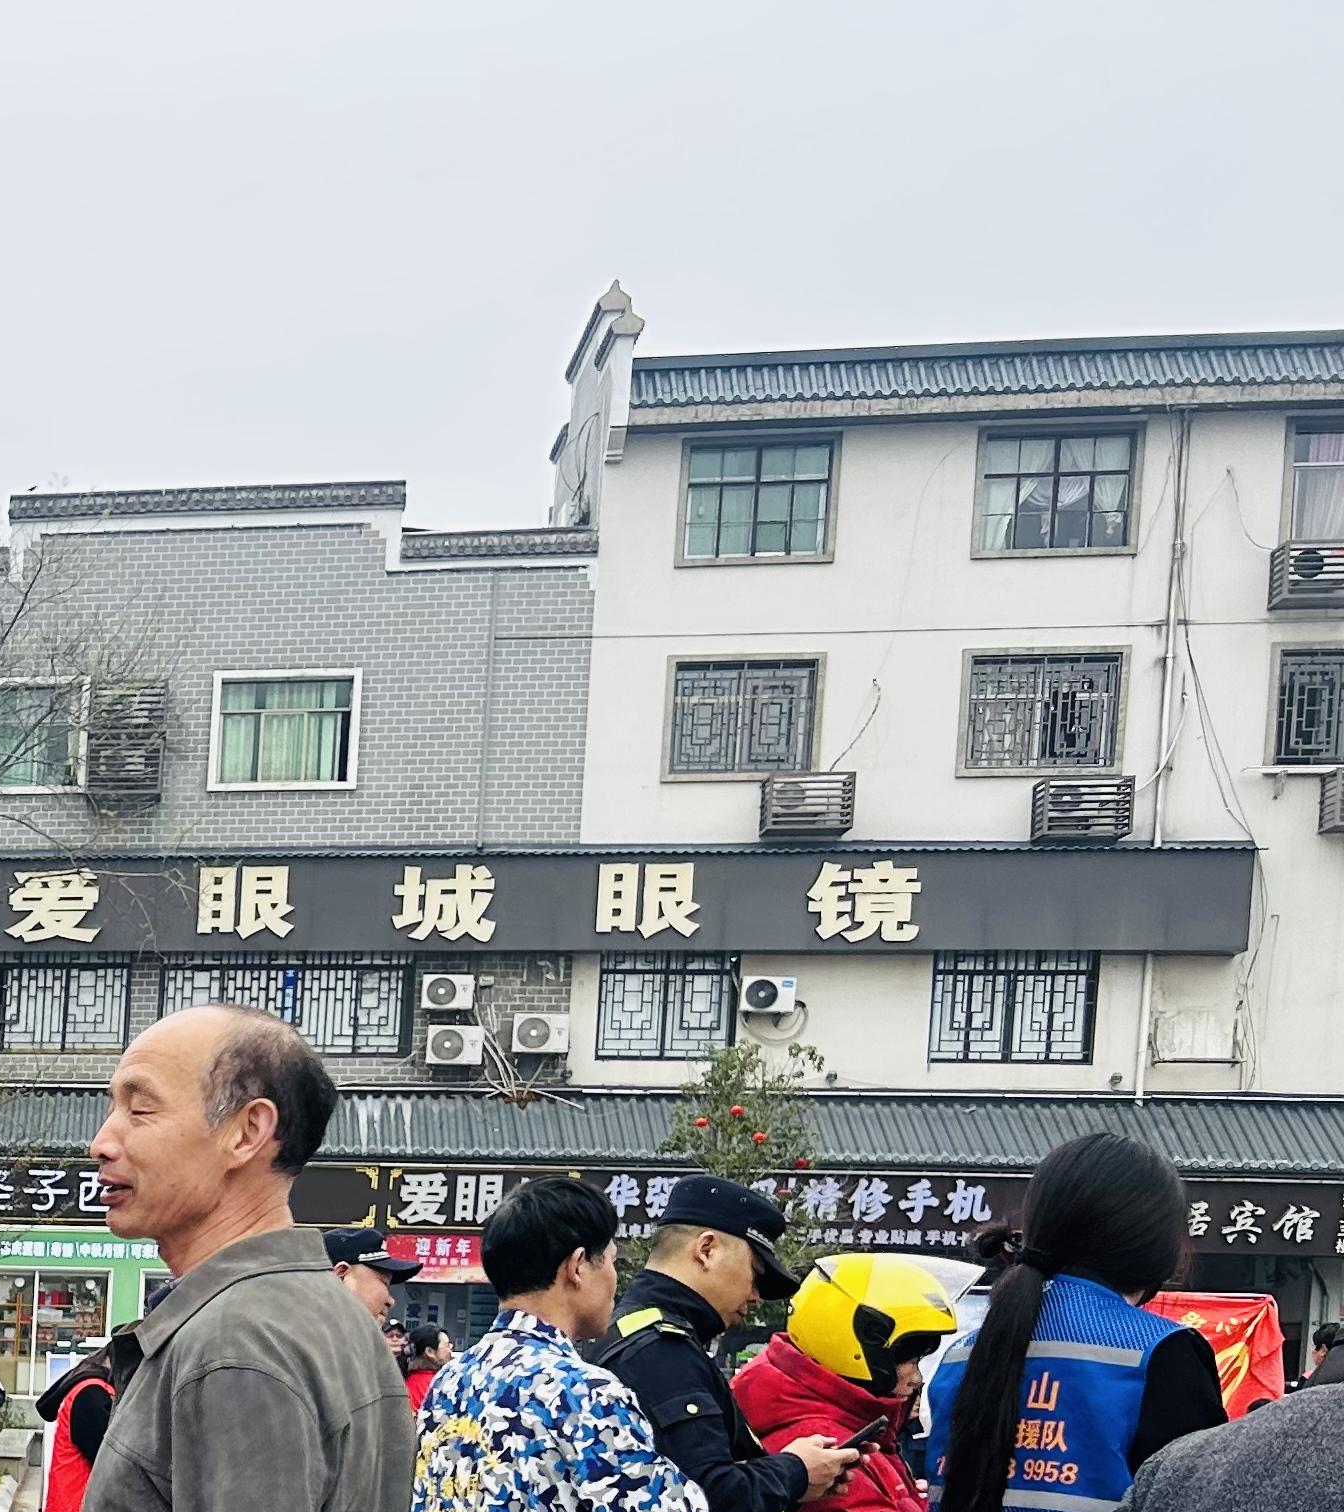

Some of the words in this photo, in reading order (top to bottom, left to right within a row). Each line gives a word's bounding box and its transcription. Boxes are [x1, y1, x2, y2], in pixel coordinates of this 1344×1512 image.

[4, 861, 924, 944] 爱眼城眼镜
[799, 1176, 992, 1224] 精修手机
[415, 1238, 472, 1257] 迎新年
[1023, 1458, 1079, 1485] 9958
